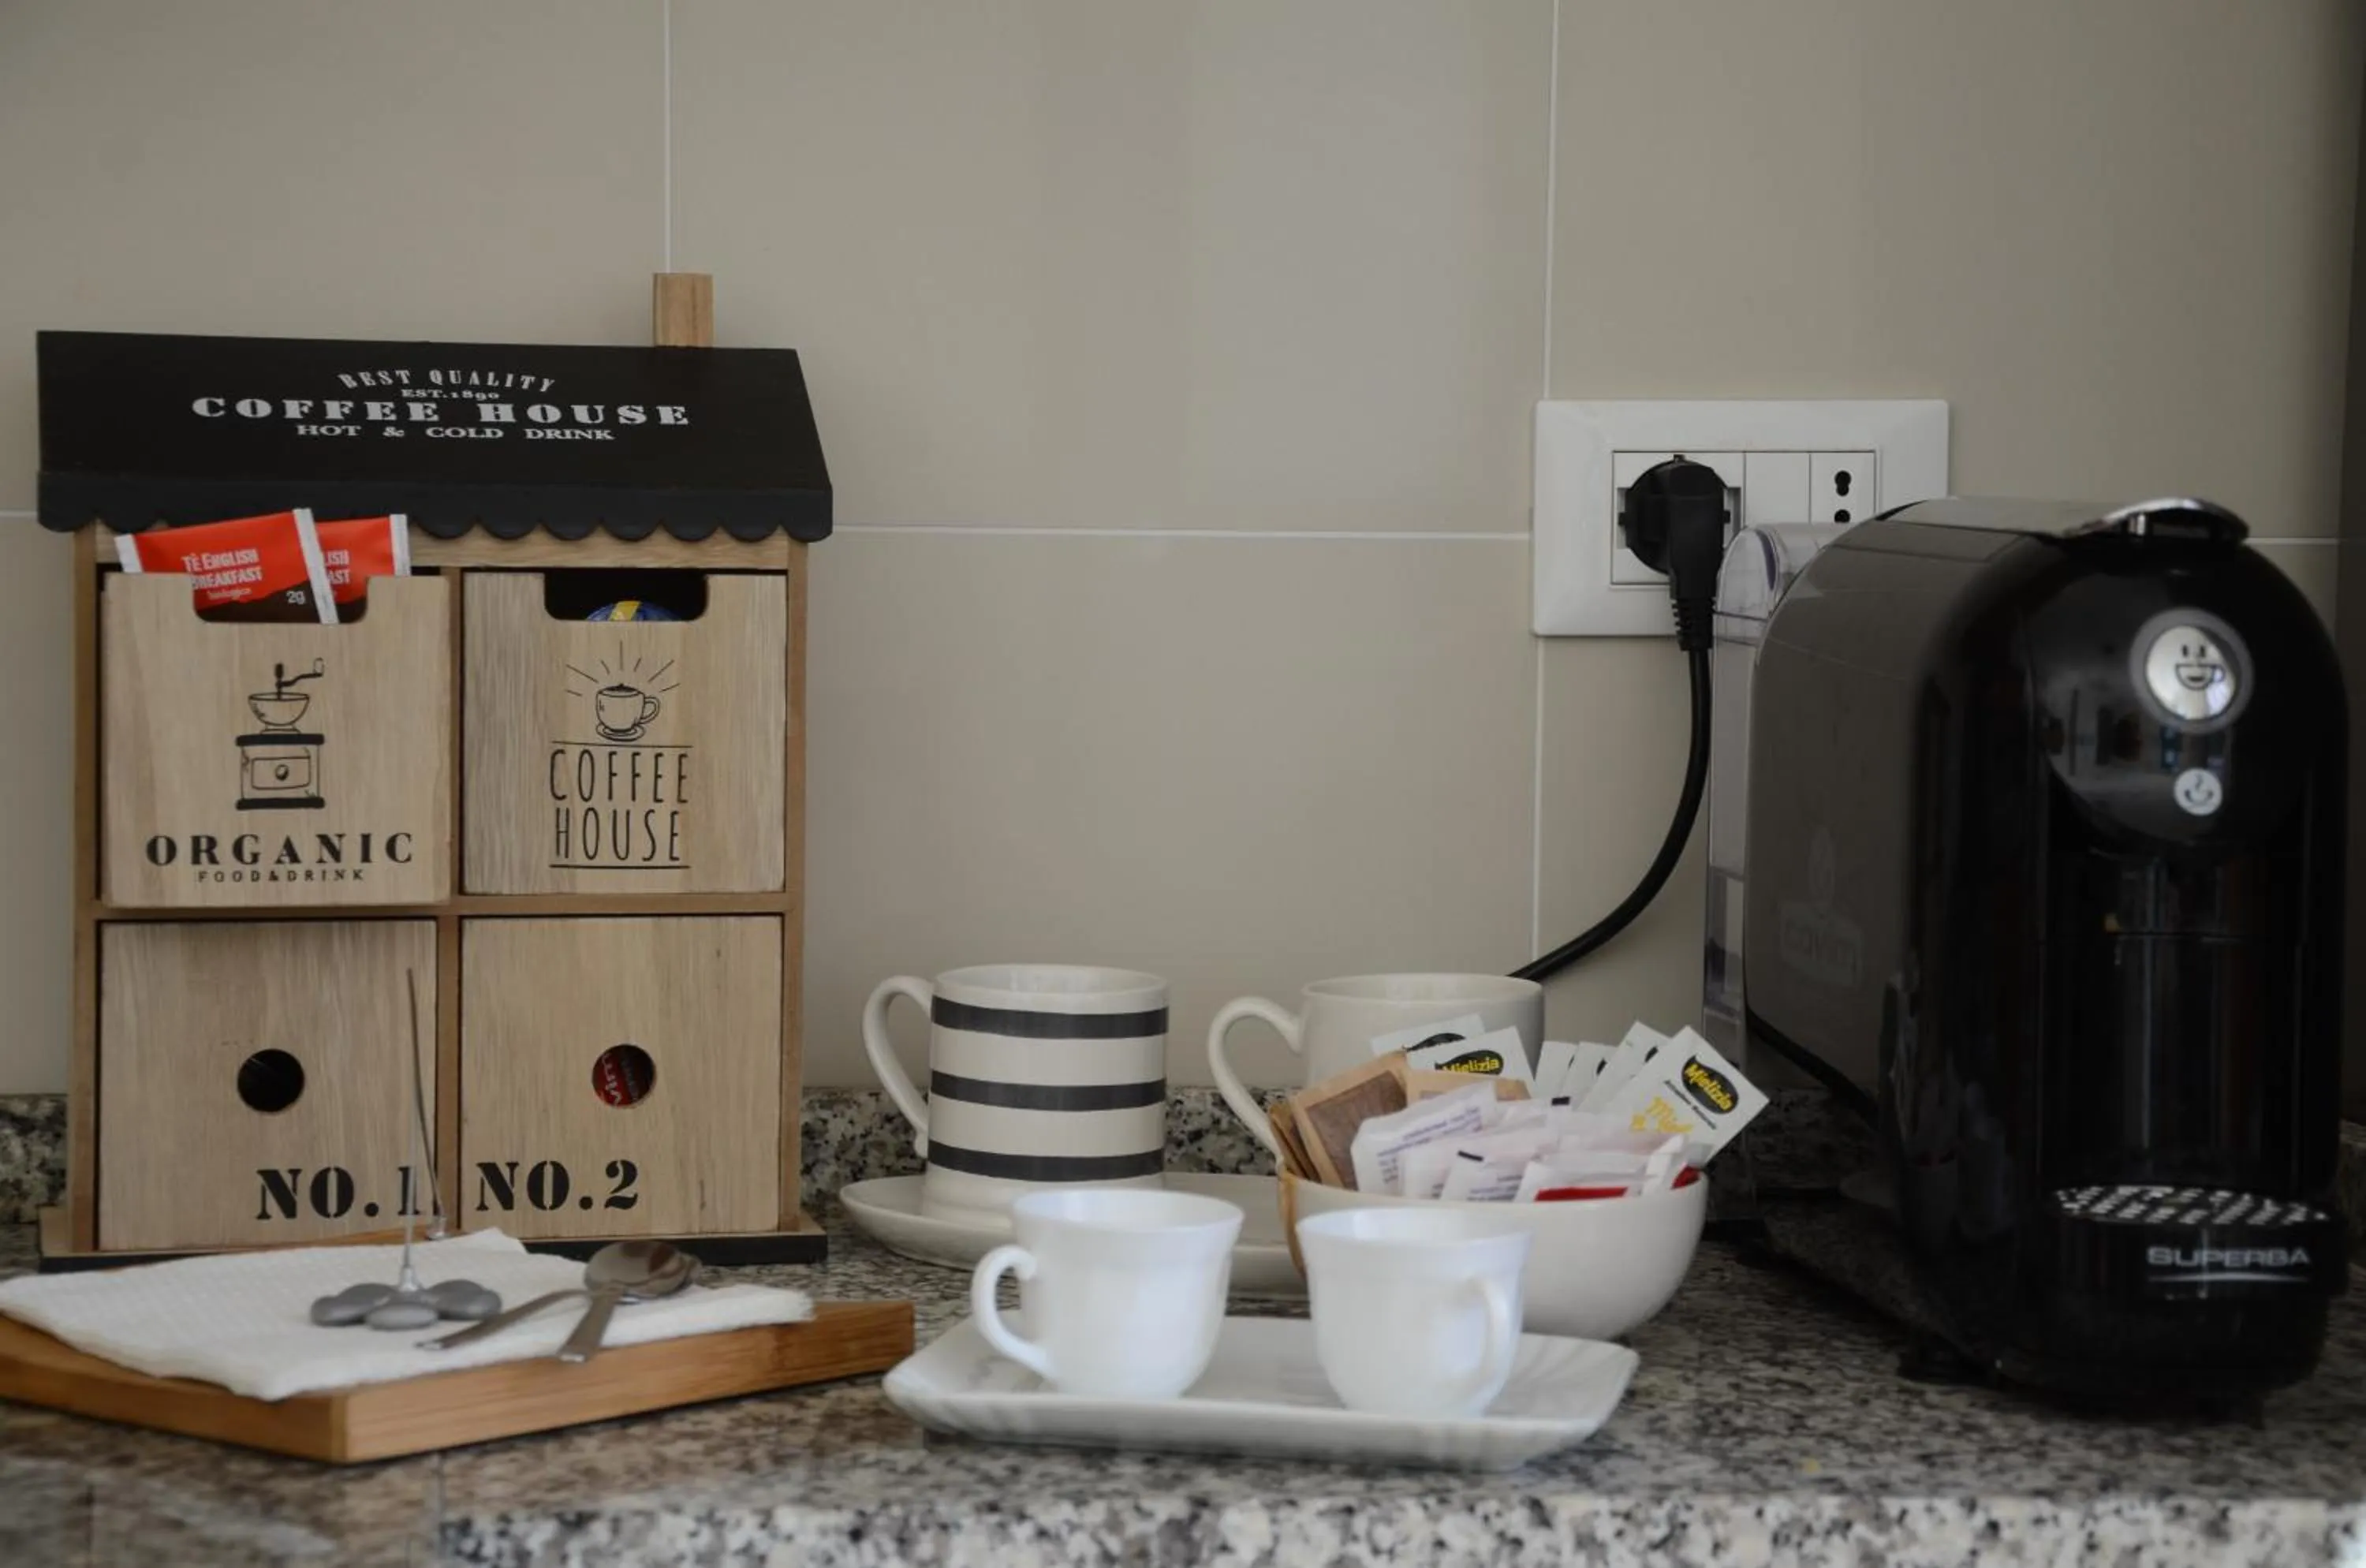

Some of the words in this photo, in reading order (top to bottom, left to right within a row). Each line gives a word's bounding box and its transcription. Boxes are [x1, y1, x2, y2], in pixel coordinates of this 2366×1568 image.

[338, 369, 411, 389] BEST
[429, 369, 555, 392] QUALITY
[192, 397, 440, 421] COFFEE
[476, 402, 689, 425] HOUSE
[297, 424, 362, 436] HOT
[383, 427, 405, 437] &
[425, 427, 505, 439] COLD
[524, 427, 615, 440] DRINK
[202, 549, 259, 569] ENGLISH
[286, 590, 306, 605] 2g
[550, 749, 689, 804] COFFEE
[555, 807, 680, 861] HOUSE
[146, 833, 412, 865] ORGANIC
[198, 868, 364, 883] FOOD&DRINK
[1684, 1062, 1733, 1111] Mielizia
[256, 1166, 421, 1220] NO.1
[476, 1159, 639, 1211] NO.2
[2147, 1246, 2310, 1267] SUPERBA
